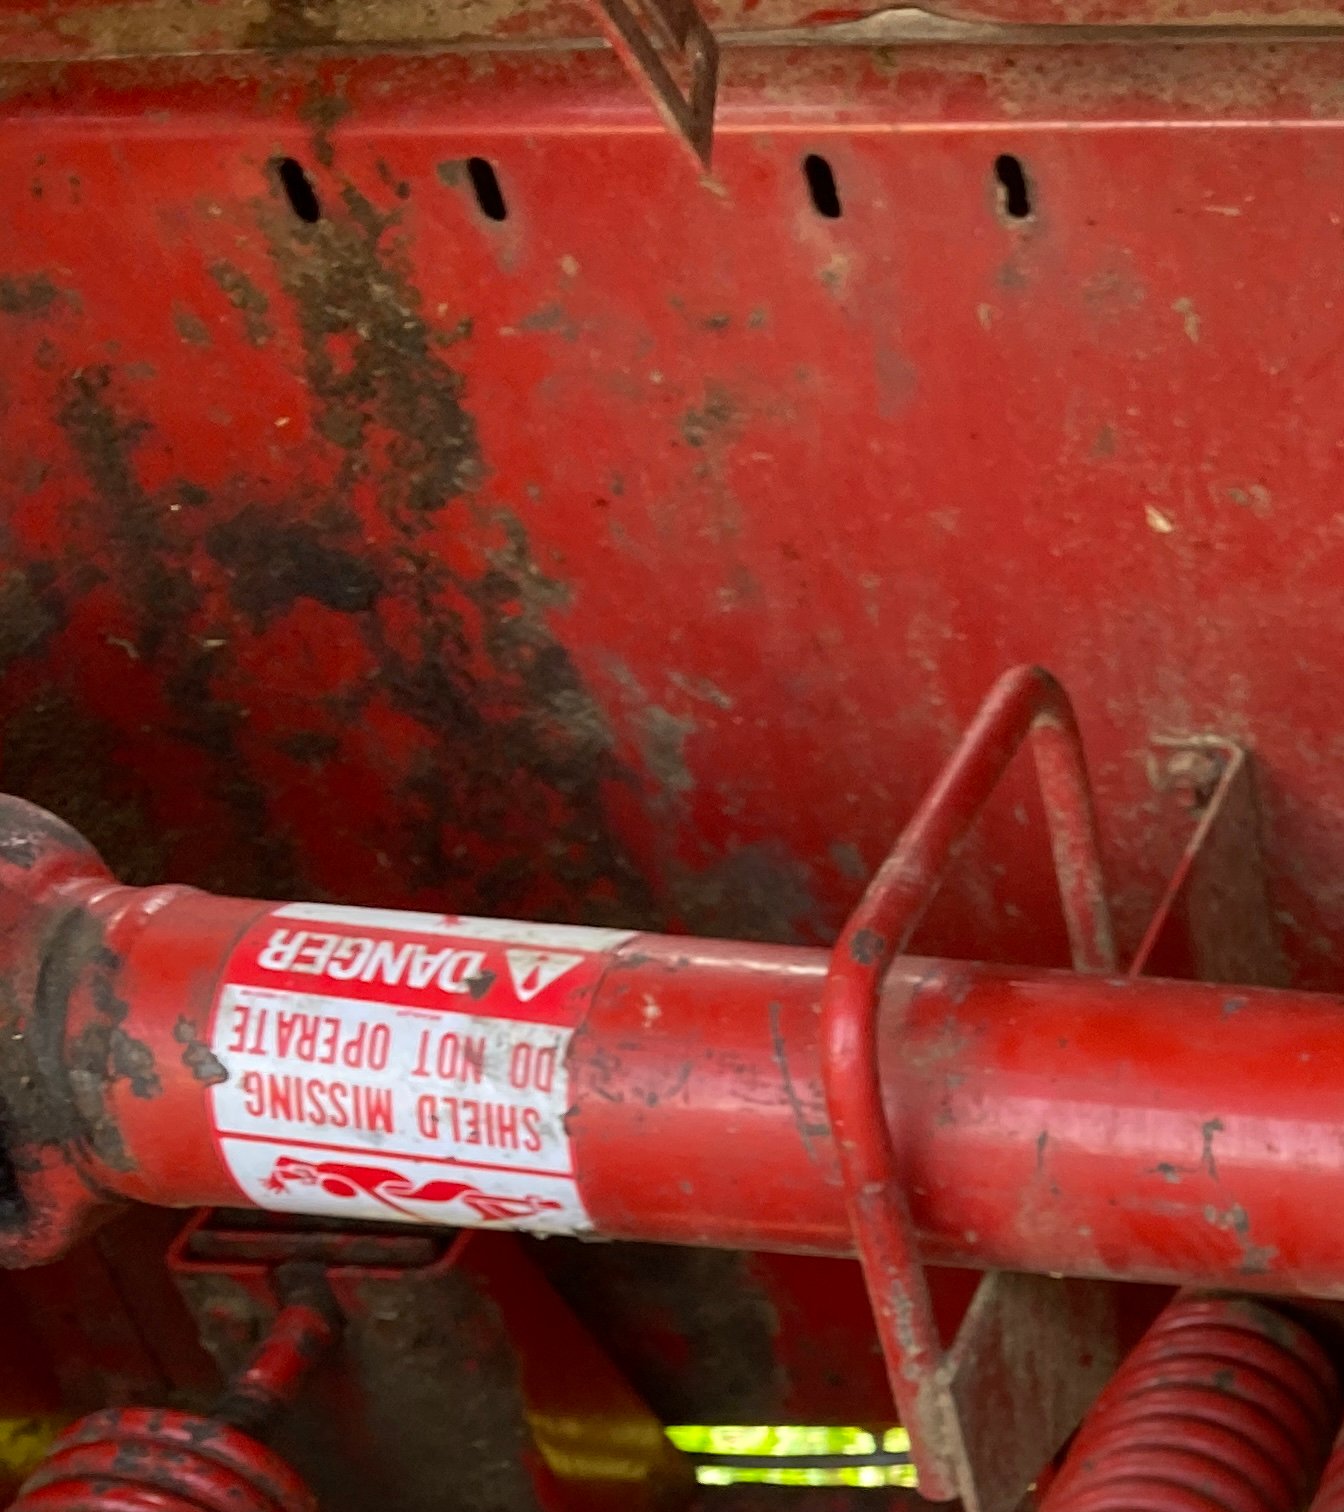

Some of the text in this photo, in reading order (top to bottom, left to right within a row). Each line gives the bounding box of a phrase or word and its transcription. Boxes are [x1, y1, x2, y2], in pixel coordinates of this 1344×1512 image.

[257, 928, 487, 994] DANGER
[228, 1005, 557, 1093] DO NOT OPERATE
[244, 1071, 541, 1152] SHIELD MISSING
